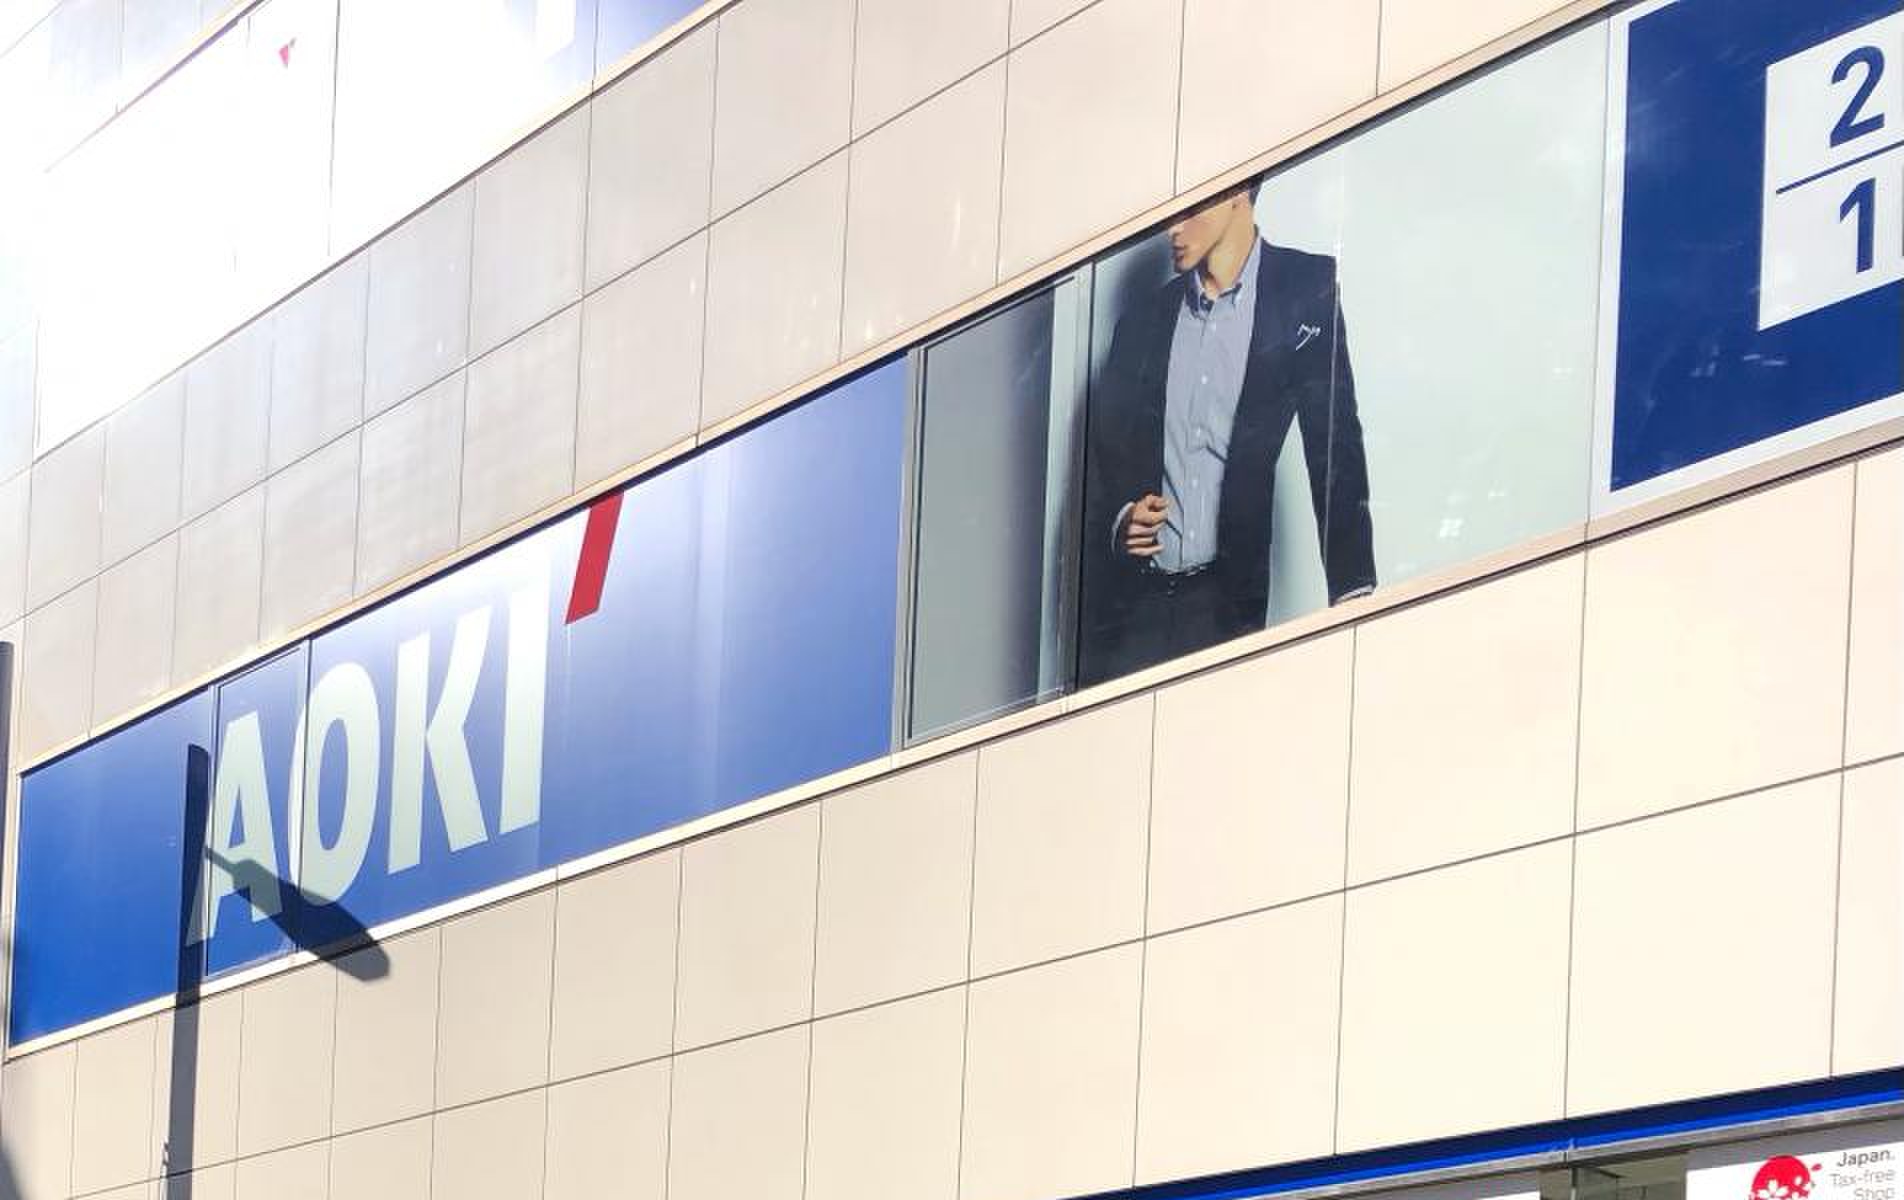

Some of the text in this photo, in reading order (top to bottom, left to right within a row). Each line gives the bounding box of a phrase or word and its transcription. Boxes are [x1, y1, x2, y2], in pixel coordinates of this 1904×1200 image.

[1830, 46, 1885, 148] 2
[187, 560, 551, 946] AOKI
[1830, 1168, 1895, 1188] Tax-free
